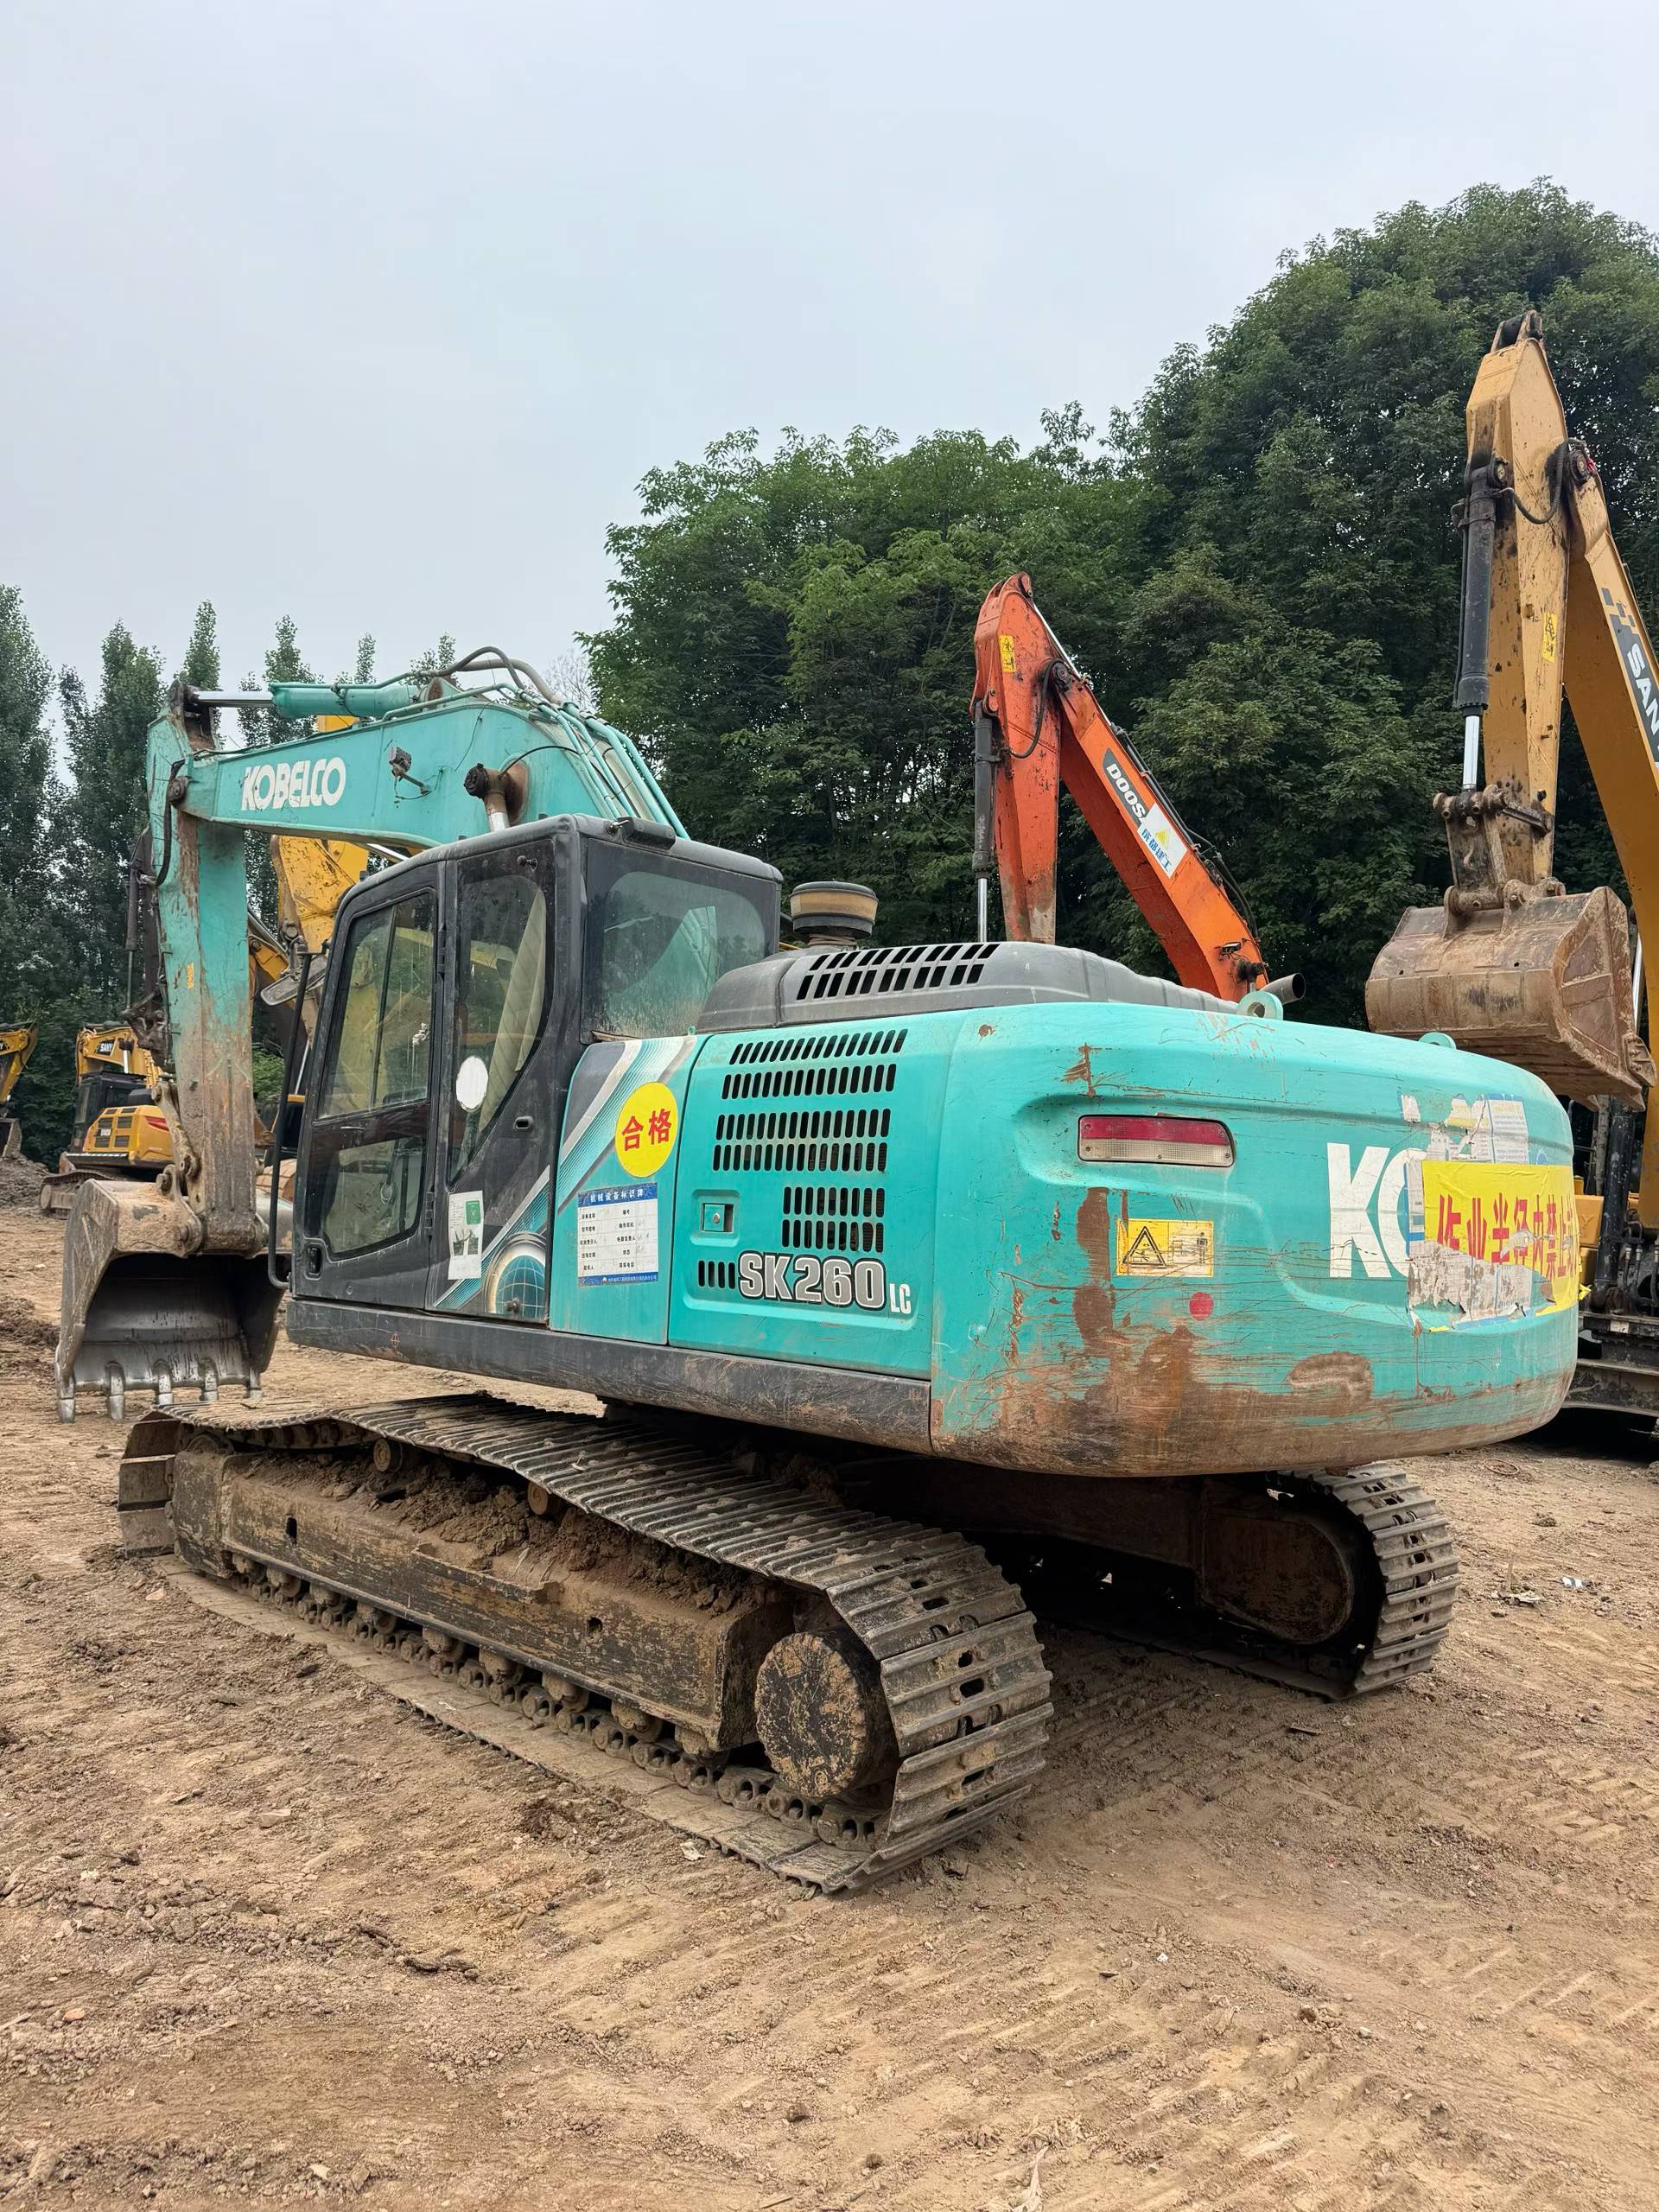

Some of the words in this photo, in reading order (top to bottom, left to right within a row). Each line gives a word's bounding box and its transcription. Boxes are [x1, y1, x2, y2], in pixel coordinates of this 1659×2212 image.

[1627, 643, 1659, 752] SAN
[241, 757, 346, 811] KOBELCO
[1106, 763, 1147, 824] DOOS
[621, 1108, 672, 1152] 合格
[738, 1249, 887, 1312] SK260
[889, 1283, 912, 1314] LC
